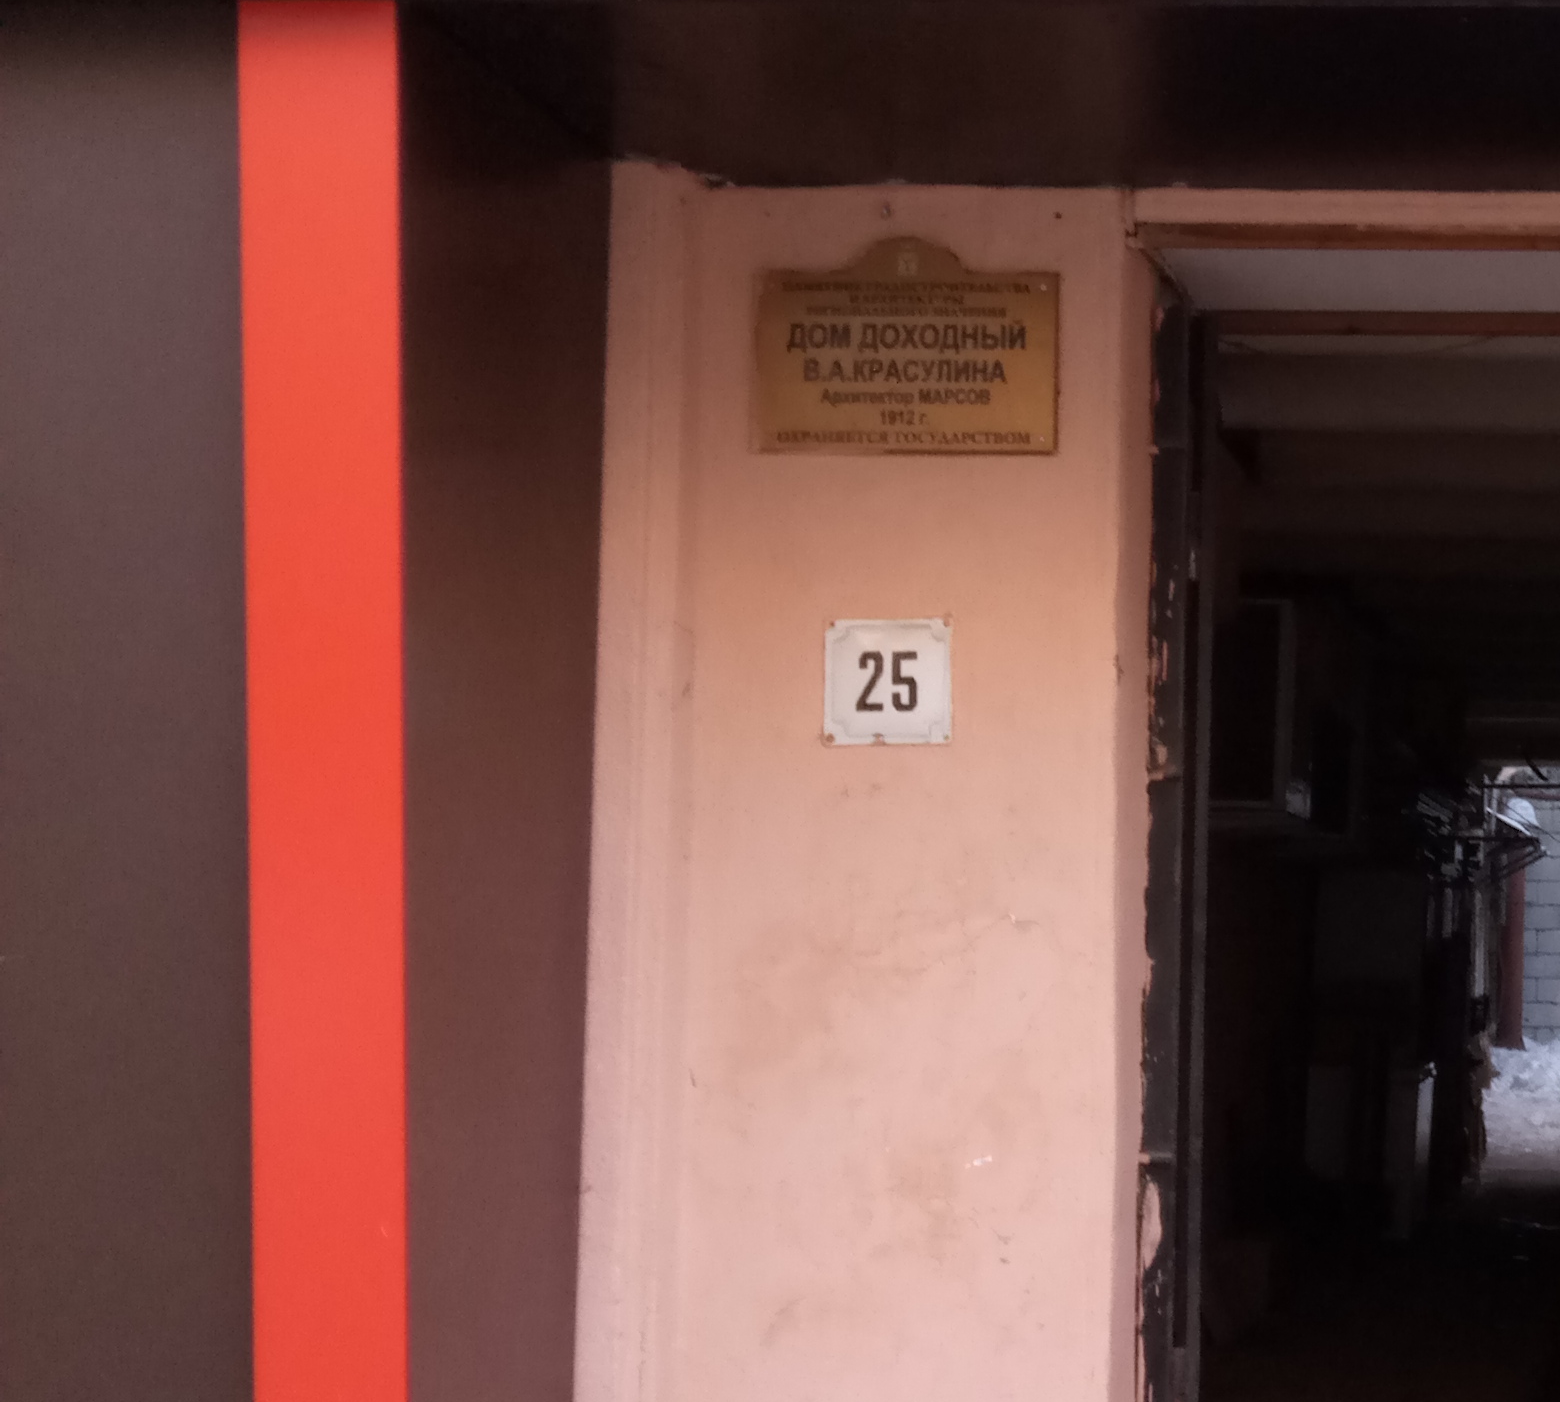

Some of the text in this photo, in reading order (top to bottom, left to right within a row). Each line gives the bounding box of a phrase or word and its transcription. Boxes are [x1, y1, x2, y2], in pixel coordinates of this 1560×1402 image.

[787, 318, 1027, 354] ДОМ ДОХОДНЫЙ
[856, 651, 918, 712] 25
